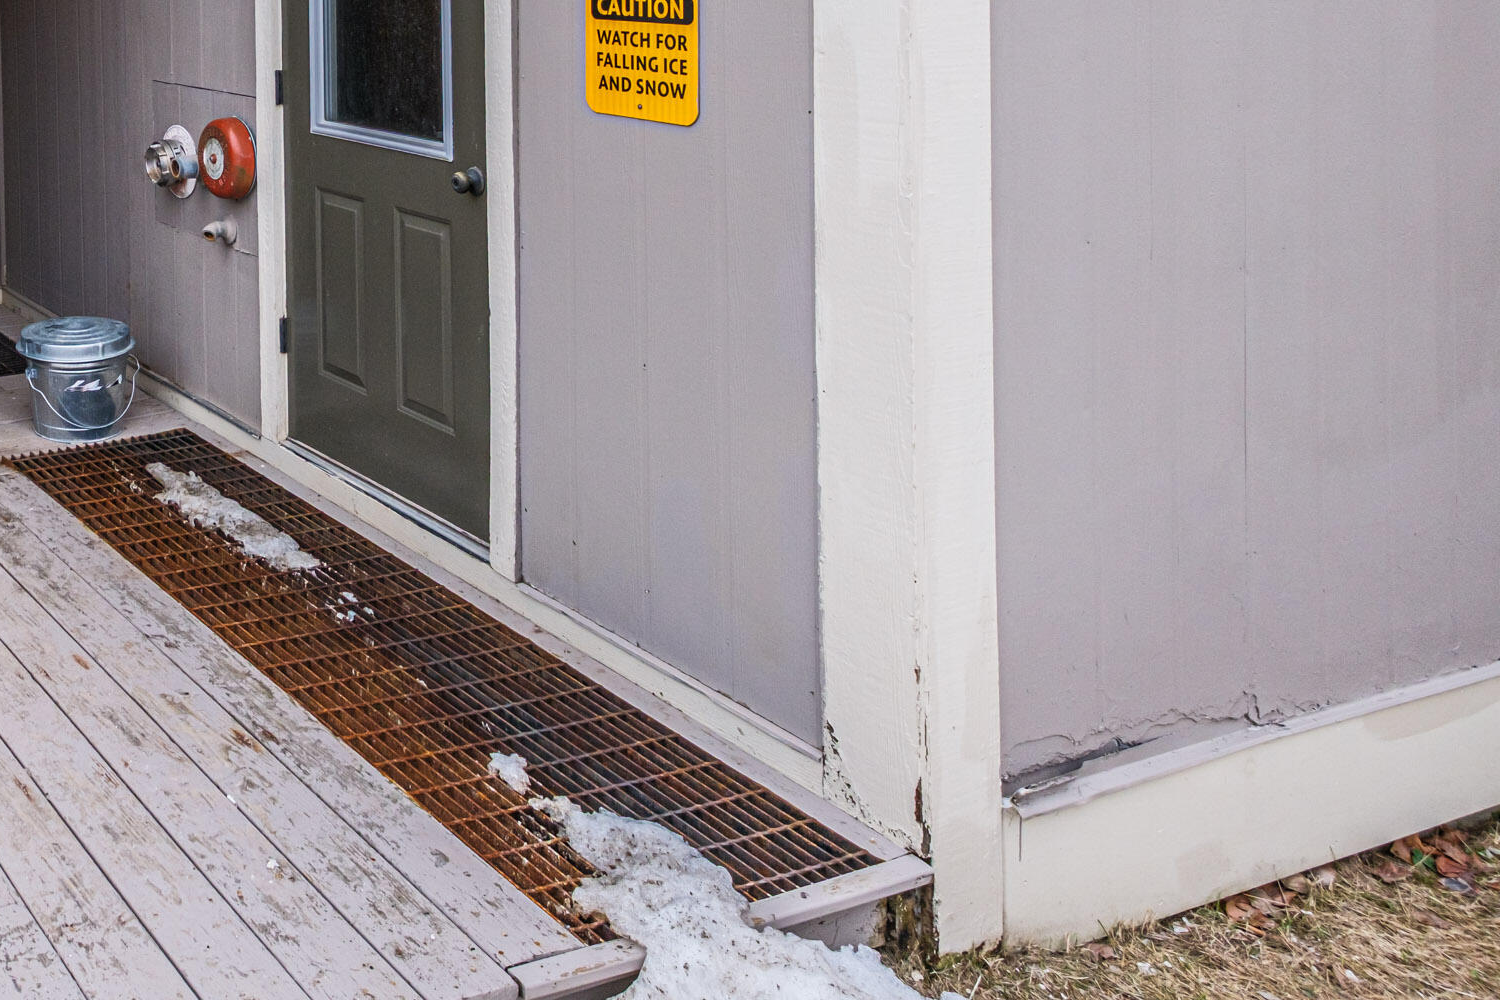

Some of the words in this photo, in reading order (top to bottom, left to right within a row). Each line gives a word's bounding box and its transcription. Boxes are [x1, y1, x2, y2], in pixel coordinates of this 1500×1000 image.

[597, 29, 650, 48] WATCH
[656, 34, 687, 51] FOR
[597, 52, 658, 73] FALLING
[664, 58, 688, 75] ICE
[599, 75, 631, 92] AND
[636, 79, 686, 99] SNOW
